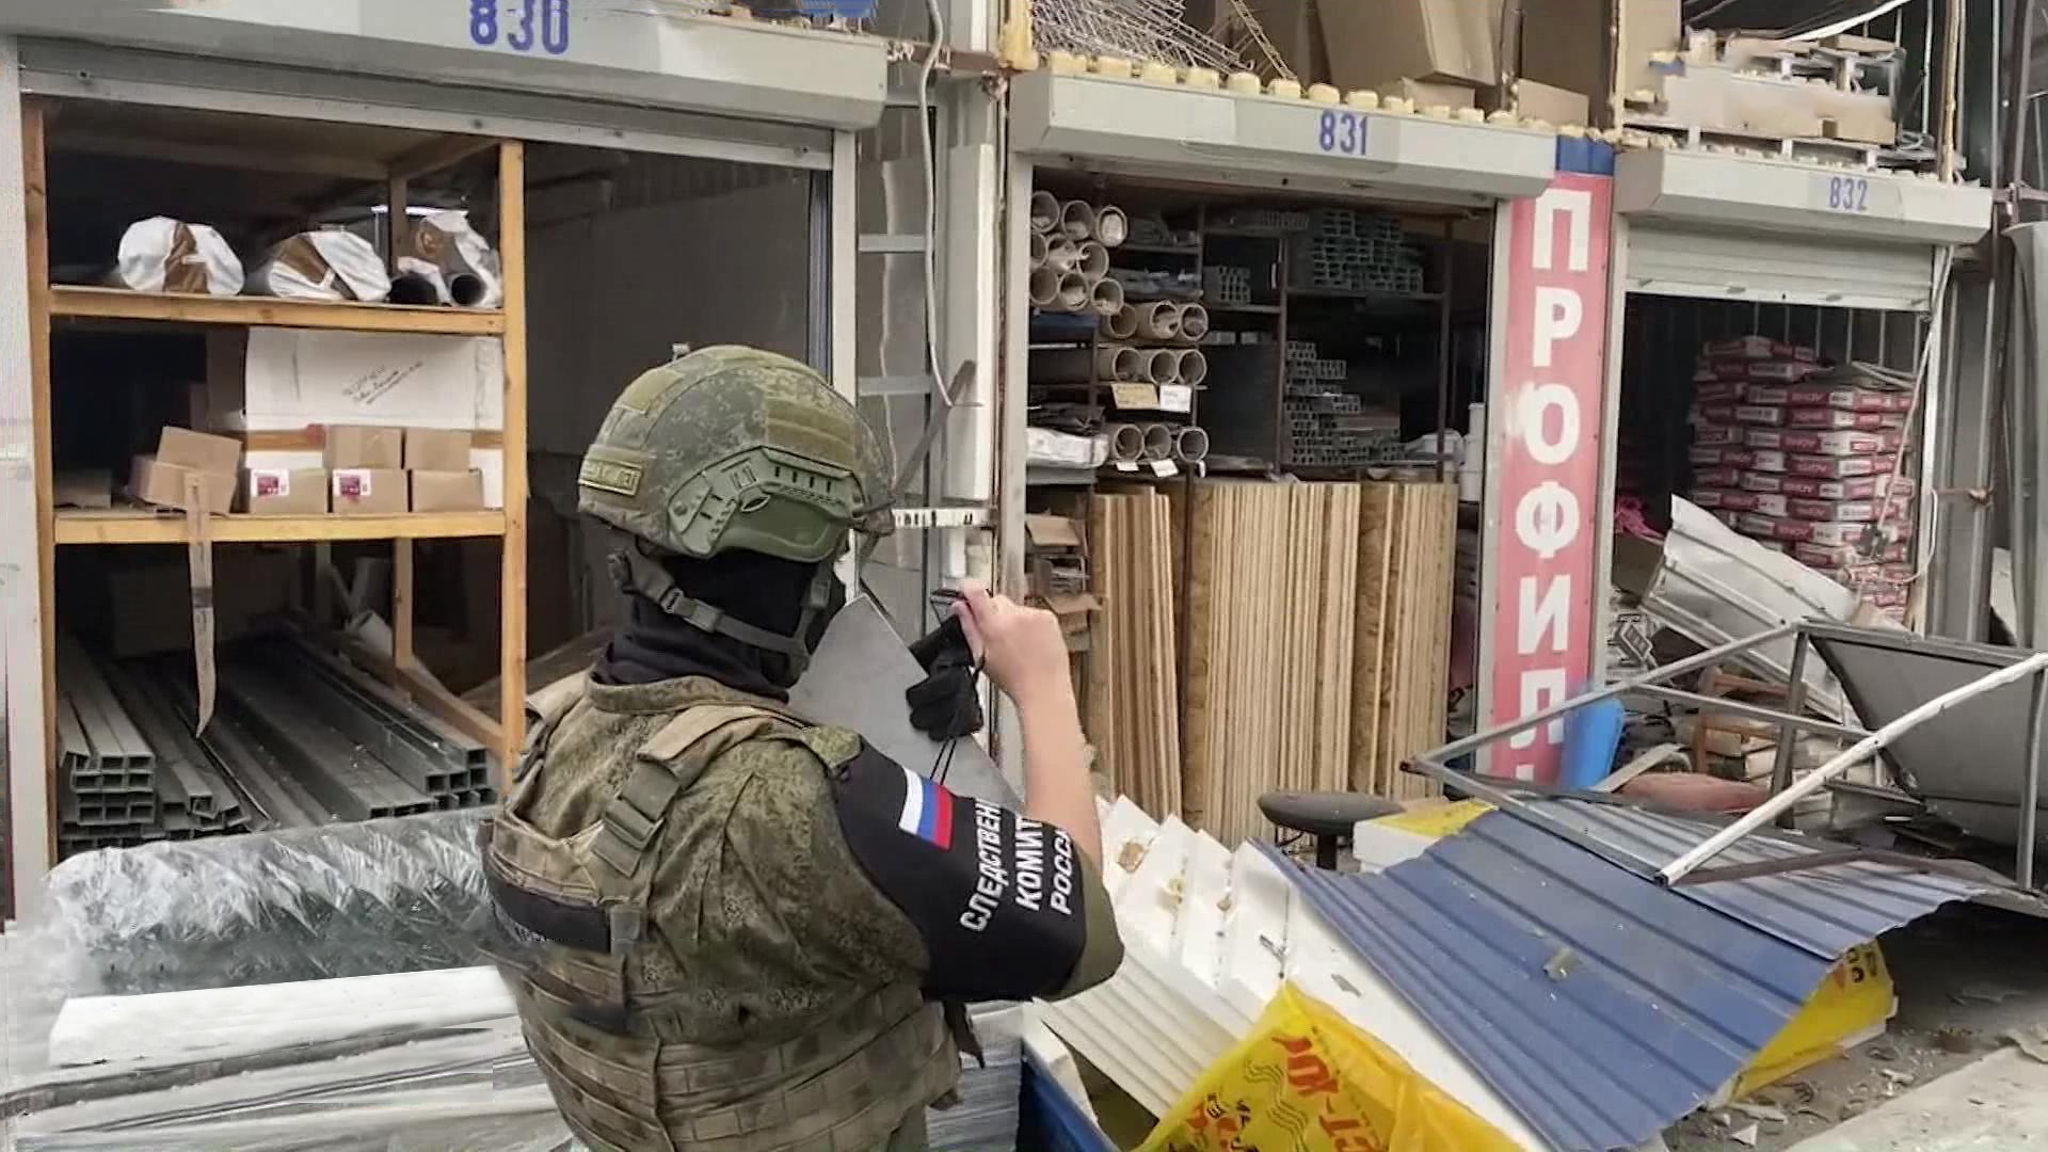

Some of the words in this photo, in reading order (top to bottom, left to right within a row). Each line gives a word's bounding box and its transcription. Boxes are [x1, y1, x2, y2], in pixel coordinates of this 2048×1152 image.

[470, 0, 569, 54] 830
[1319, 110, 1368, 156] 831
[1830, 176, 1868, 211] 832
[1510, 186, 1592, 782] ПРОФИЛ
[960, 797, 1009, 932] СЛЕДСТВЕН
